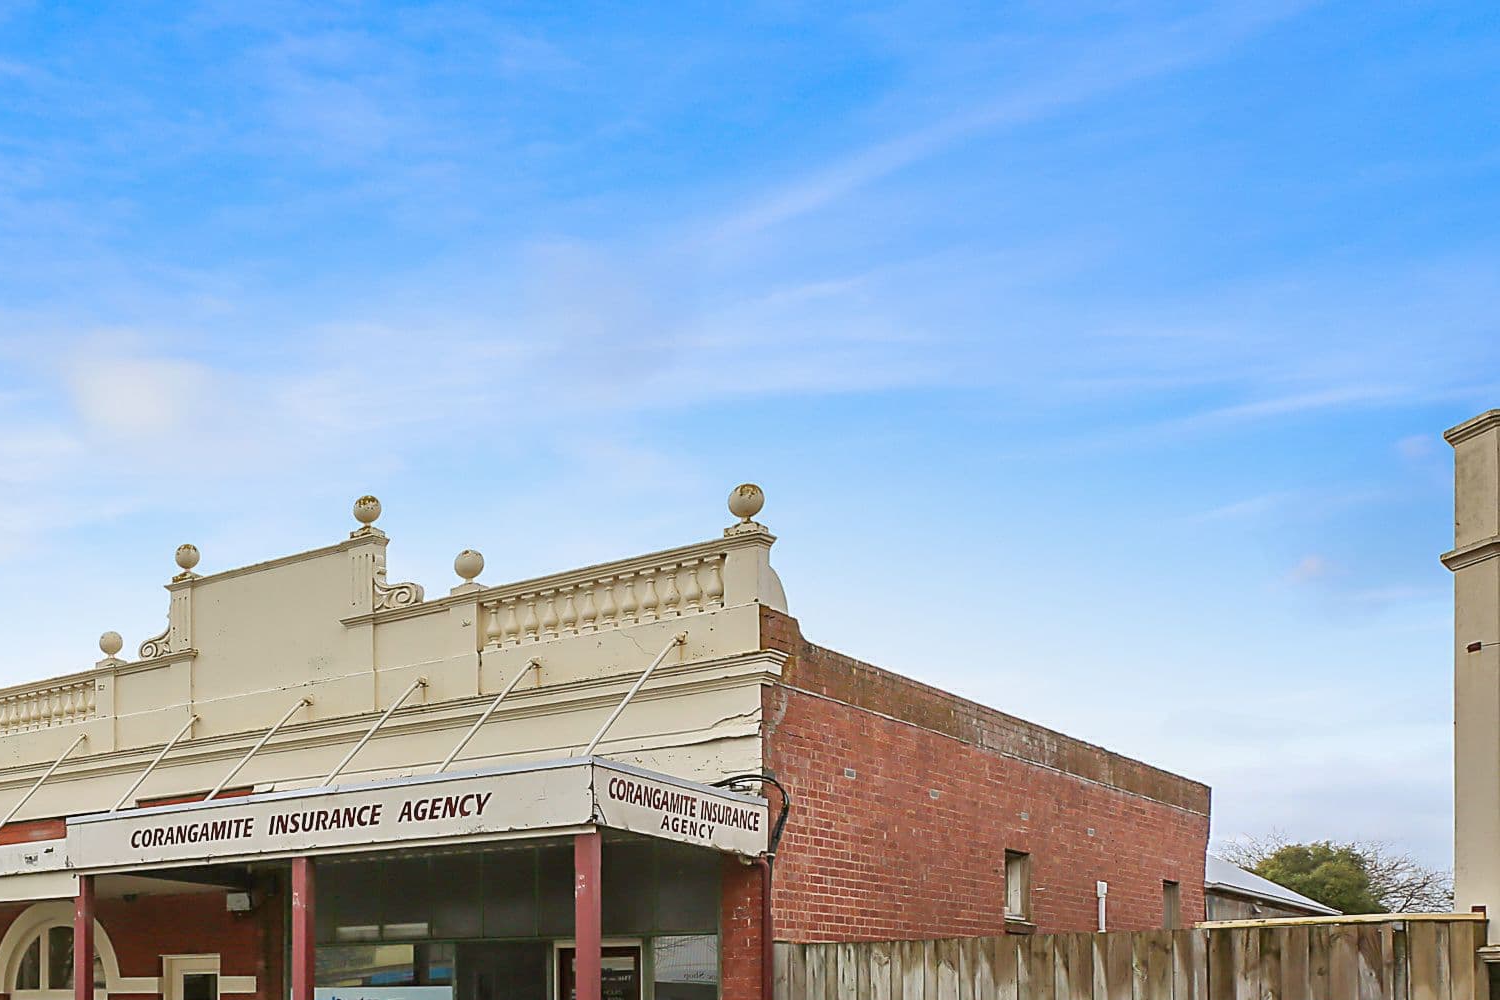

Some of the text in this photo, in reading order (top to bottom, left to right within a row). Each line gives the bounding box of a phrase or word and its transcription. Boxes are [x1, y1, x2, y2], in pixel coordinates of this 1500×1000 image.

[130, 792, 492, 849] CORANGAMITE INSURANCE AGENCY
[608, 777, 761, 832] CORANGAMITE INSURANCE
[660, 815, 715, 840] AGENCY
